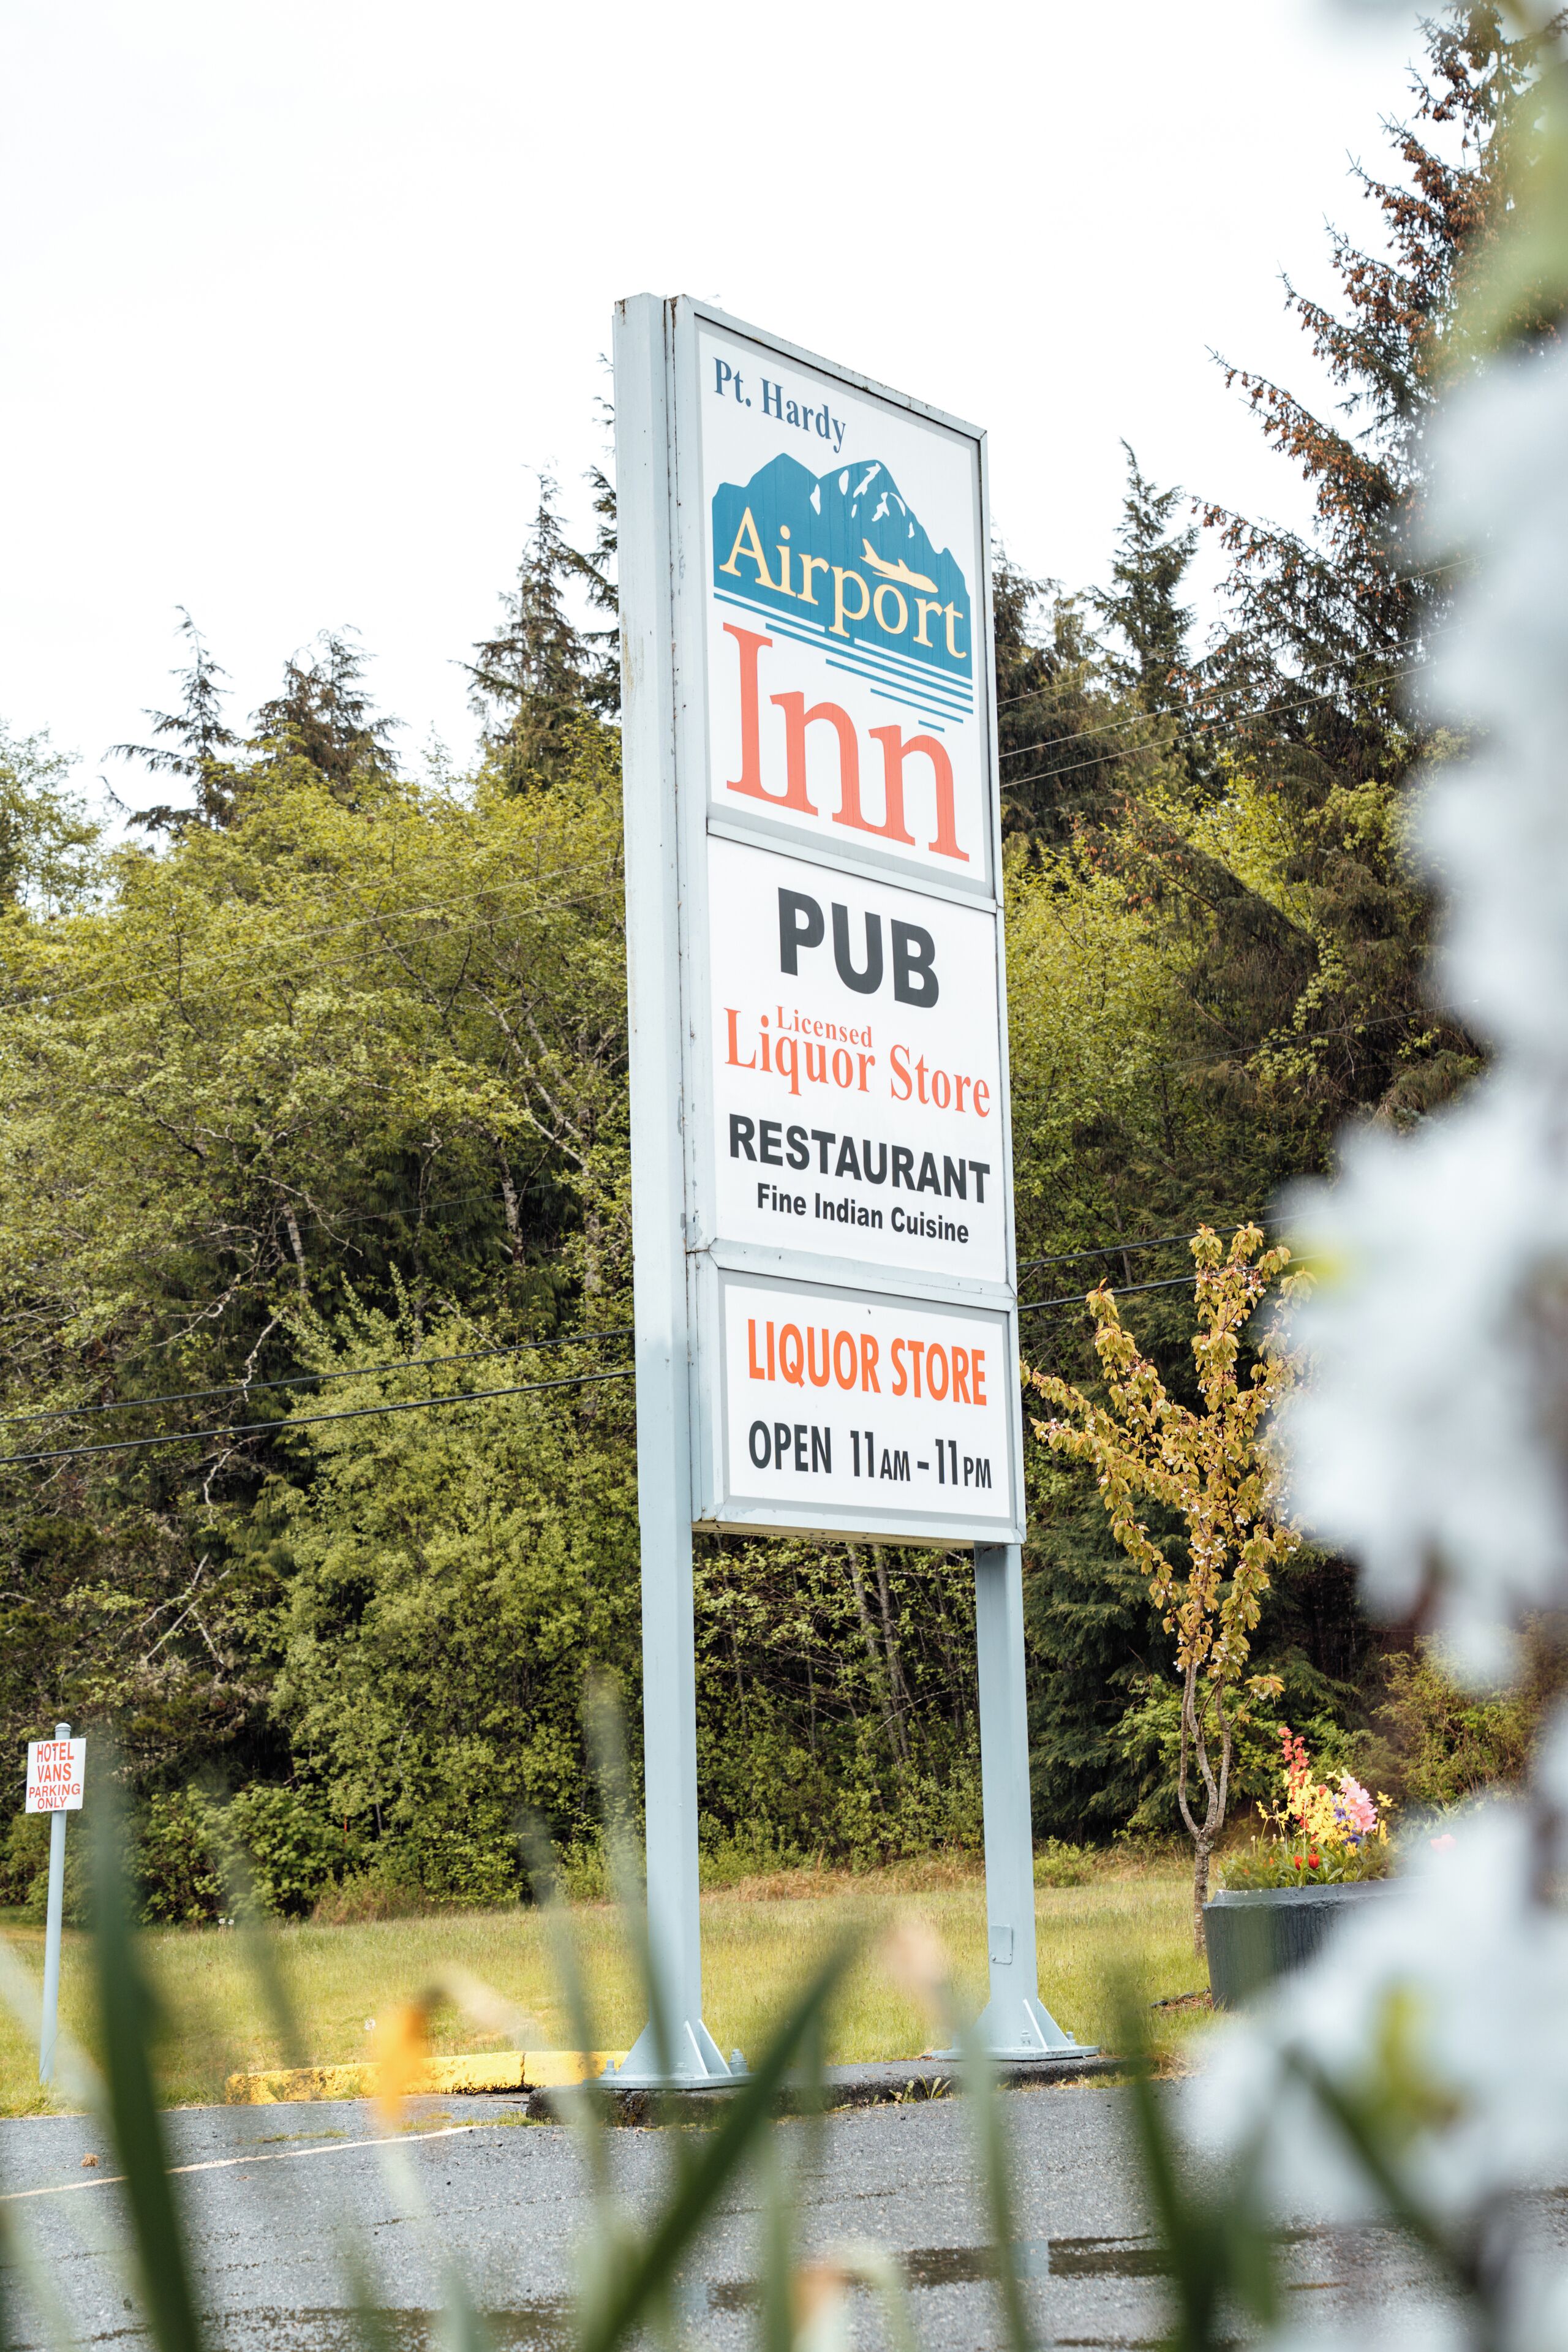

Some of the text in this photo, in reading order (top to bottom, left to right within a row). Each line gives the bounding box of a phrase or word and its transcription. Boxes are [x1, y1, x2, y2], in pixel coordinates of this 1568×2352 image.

[713, 357, 846, 453] Pt. Hardy
[719, 506, 967, 658] Airport
[723, 622, 970, 862] Inn
[778, 887, 940, 1008] PUB
[723, 1007, 990, 1118] Liquor Store
[775, 1005, 873, 1048] Licensed
[729, 1113, 990, 1204] RESTAURANT
[757, 1183, 969, 1243] Fine Indian Cuisine
[748, 1319, 987, 1406] LIQUOR STORE
[748, 1420, 832, 1474] OPEN
[37, 1742, 74, 1763] HOTEL
[37, 1763, 72, 1783] VANS
[29, 1783, 81, 1798] PARKING
[37, 1796, 67, 1810] ONLY
